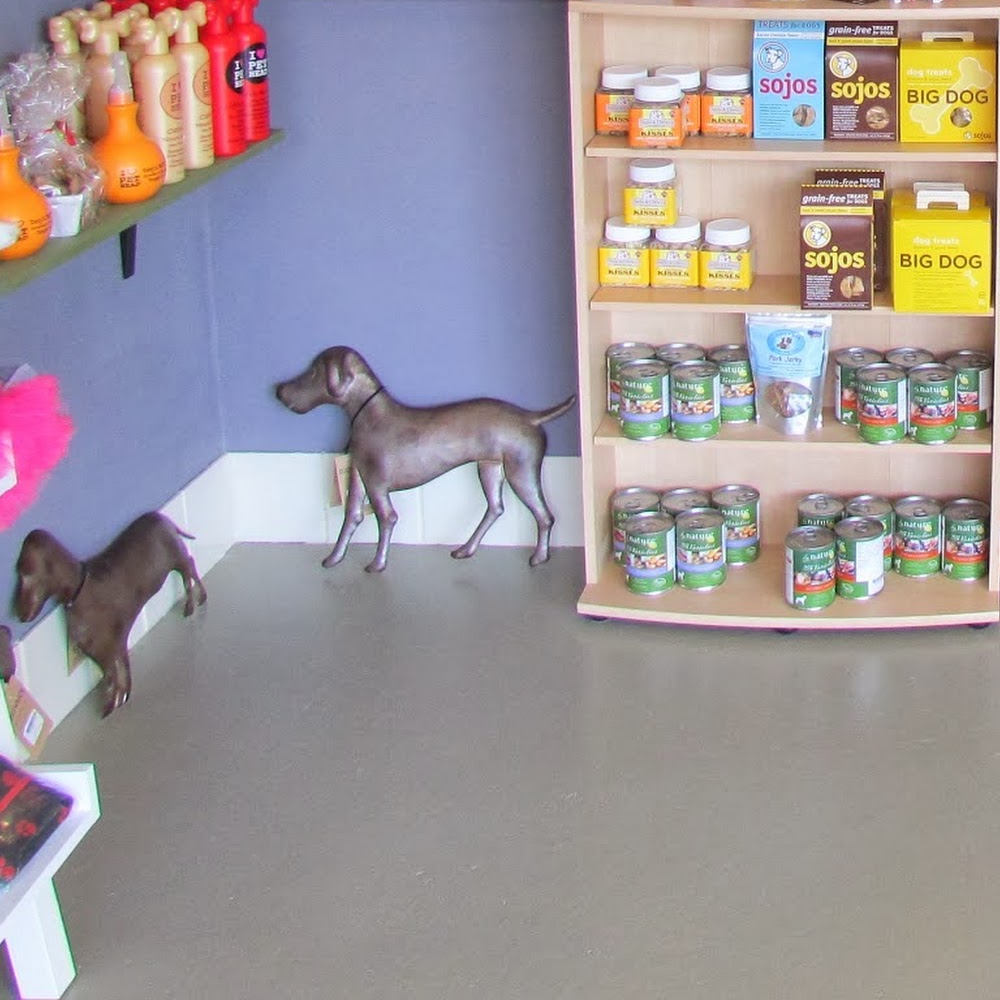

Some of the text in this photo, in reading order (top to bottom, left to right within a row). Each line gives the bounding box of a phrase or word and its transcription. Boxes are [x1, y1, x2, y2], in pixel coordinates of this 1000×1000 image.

[828, 25, 872, 36] grain-free
[906, 68, 953, 78] dog treats
[759, 72, 818, 100] sojos
[831, 76, 891, 105] sojos
[907, 89, 989, 104] BIG DOG
[640, 130, 674, 138] KISSES
[801, 193, 847, 204] grain-free
[633, 209, 666, 217] KISSES
[912, 236, 960, 246] dog treats
[804, 245, 865, 274] sojos
[900, 253, 983, 269] BIG DOG
[657, 269, 689, 277] KISSES
